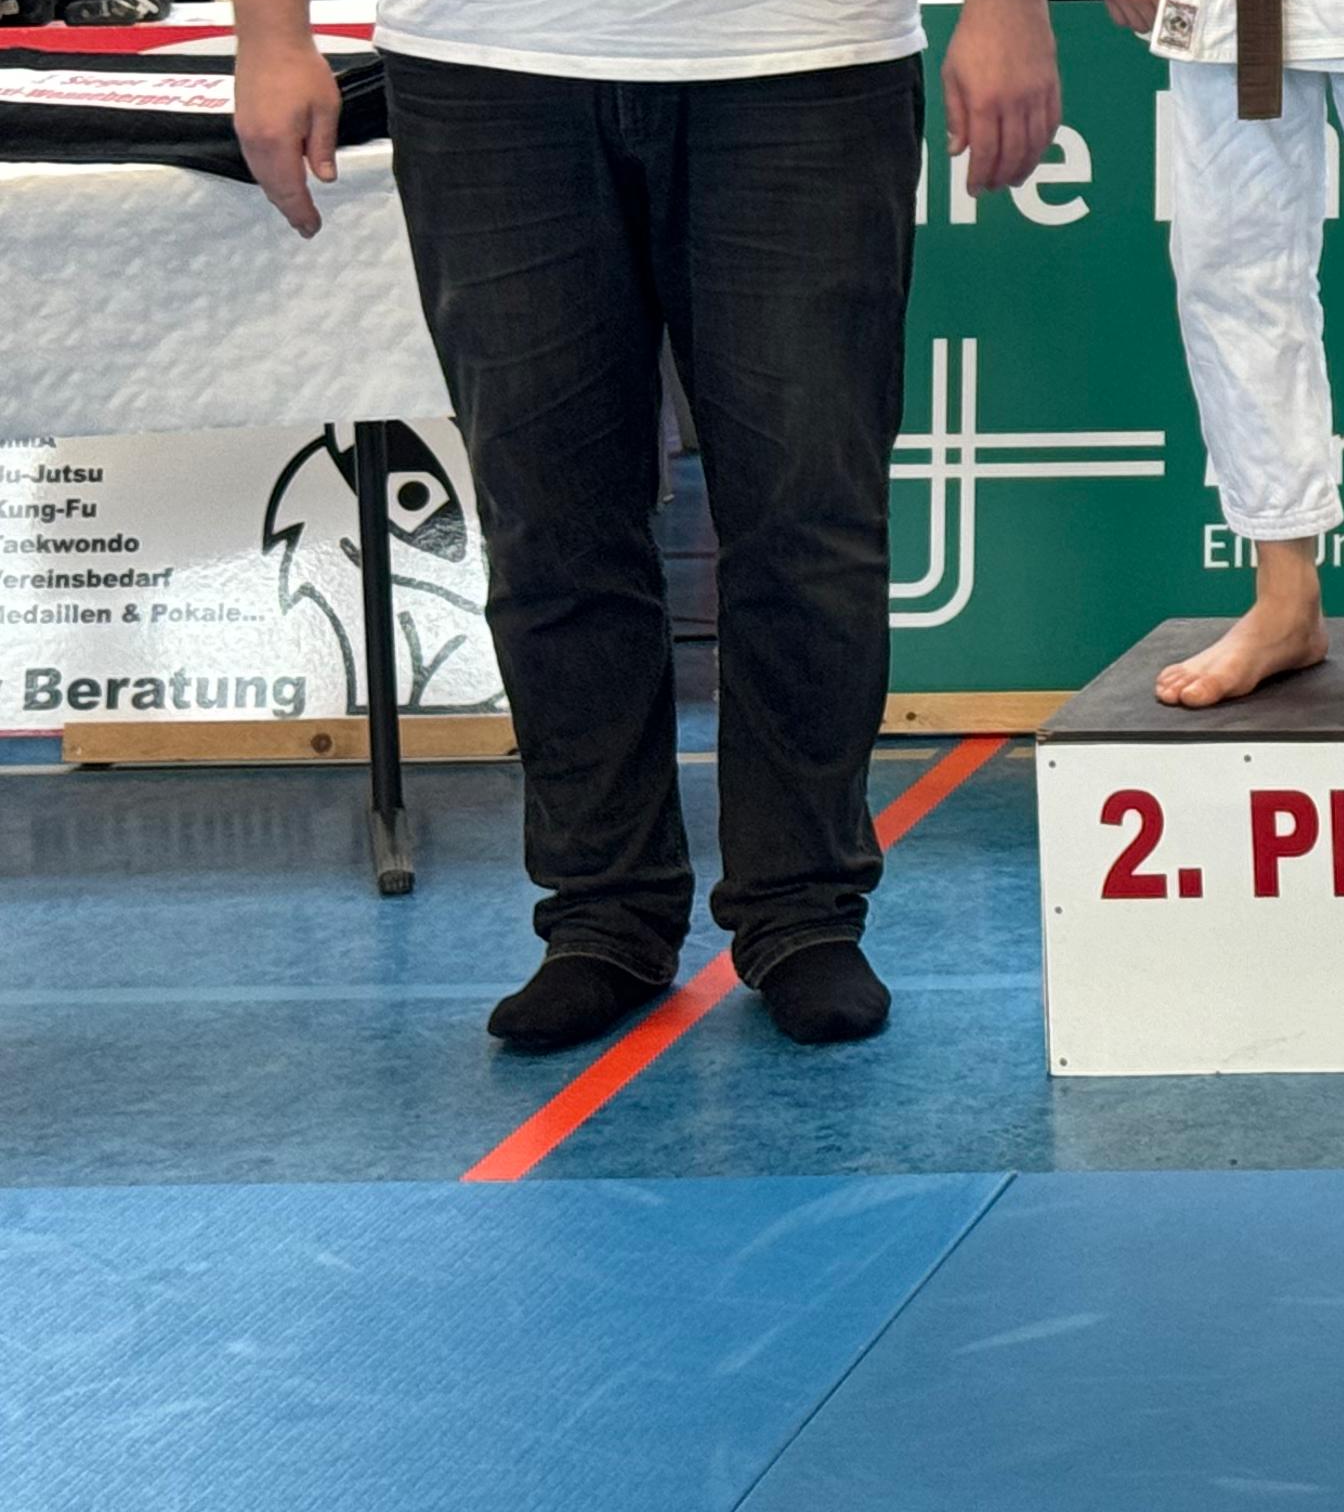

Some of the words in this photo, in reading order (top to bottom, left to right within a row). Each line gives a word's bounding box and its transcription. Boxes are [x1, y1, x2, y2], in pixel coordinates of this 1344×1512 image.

[0, 534, 140, 554] aekwondo
[0, 567, 174, 589] ereinsbedarf
[122, 603, 141, 624] &
[23, 667, 307, 718] Beratung
[1100, 789, 1203, 899] 2.
